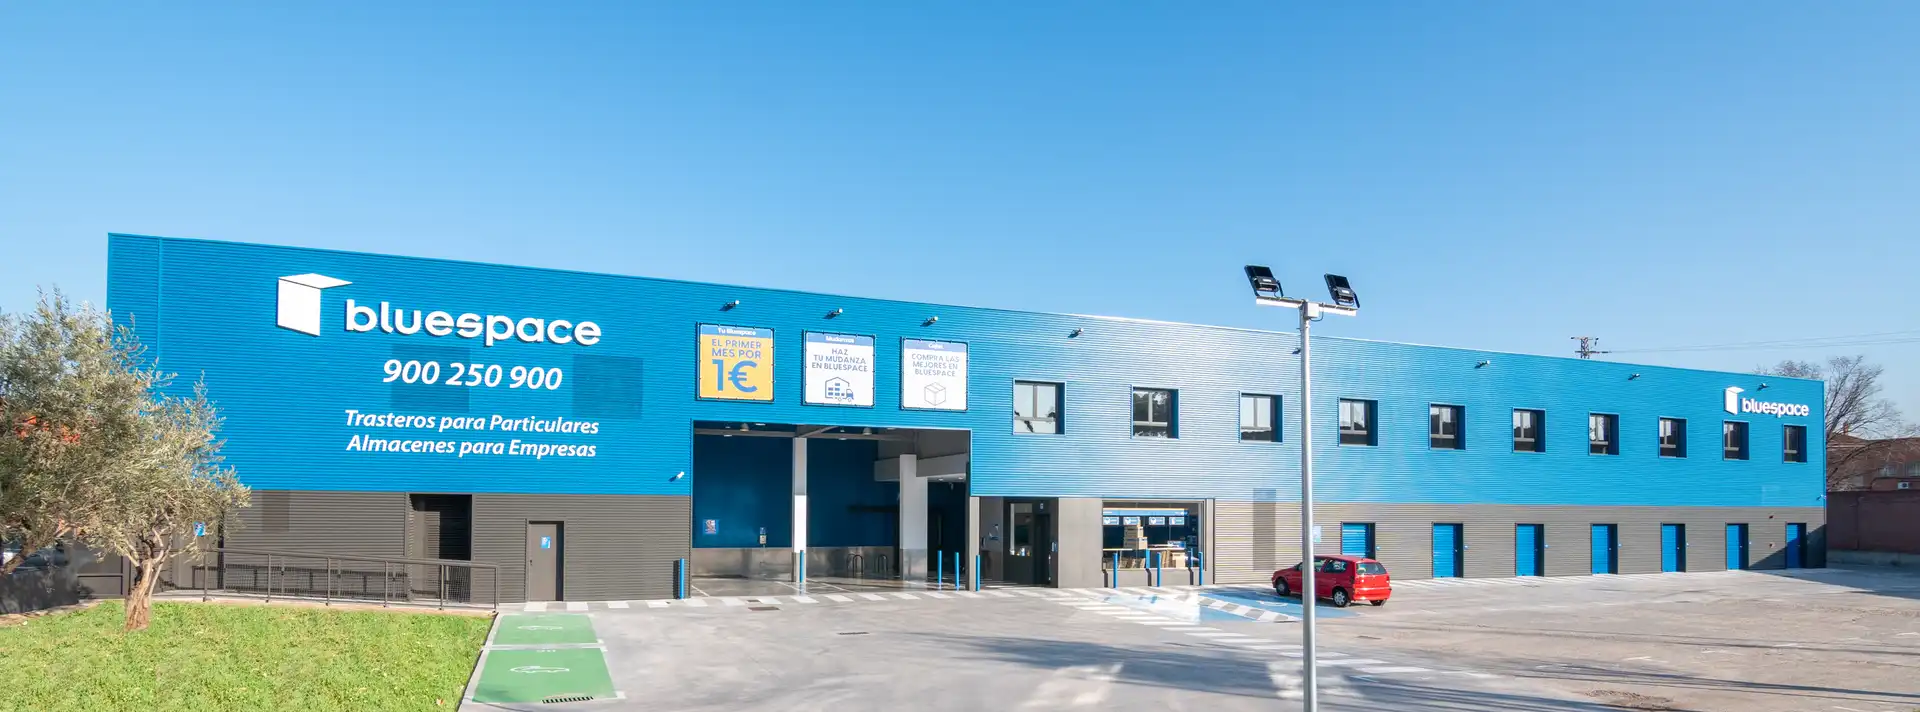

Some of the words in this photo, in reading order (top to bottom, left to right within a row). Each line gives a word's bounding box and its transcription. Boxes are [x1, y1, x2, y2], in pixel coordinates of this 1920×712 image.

[345, 298, 602, 347] bluespace
[726, 340, 761, 349] PRIMER
[712, 348, 735, 357] MES
[739, 350, 761, 359] POR
[832, 348, 848, 356] HAZ
[826, 356, 866, 364] MUDANZA
[912, 353, 944, 362] COMPRA
[946, 355, 960, 363] LAS
[824, 363, 868, 372] BLUESPACE
[913, 361, 947, 369] MEJORES
[383, 358, 440, 385] 900
[446, 362, 503, 388] 250
[509, 366, 563, 391] 900
[712, 359, 758, 393] 1€
[1741, 398, 1809, 418] bluespace
[345, 409, 435, 429] Trasteros
[439, 416, 486, 432] para
[490, 414, 599, 434] Particulares
[346, 434, 456, 455] Almacenes
[459, 441, 505, 457] para
[509, 440, 596, 460] Empresas
